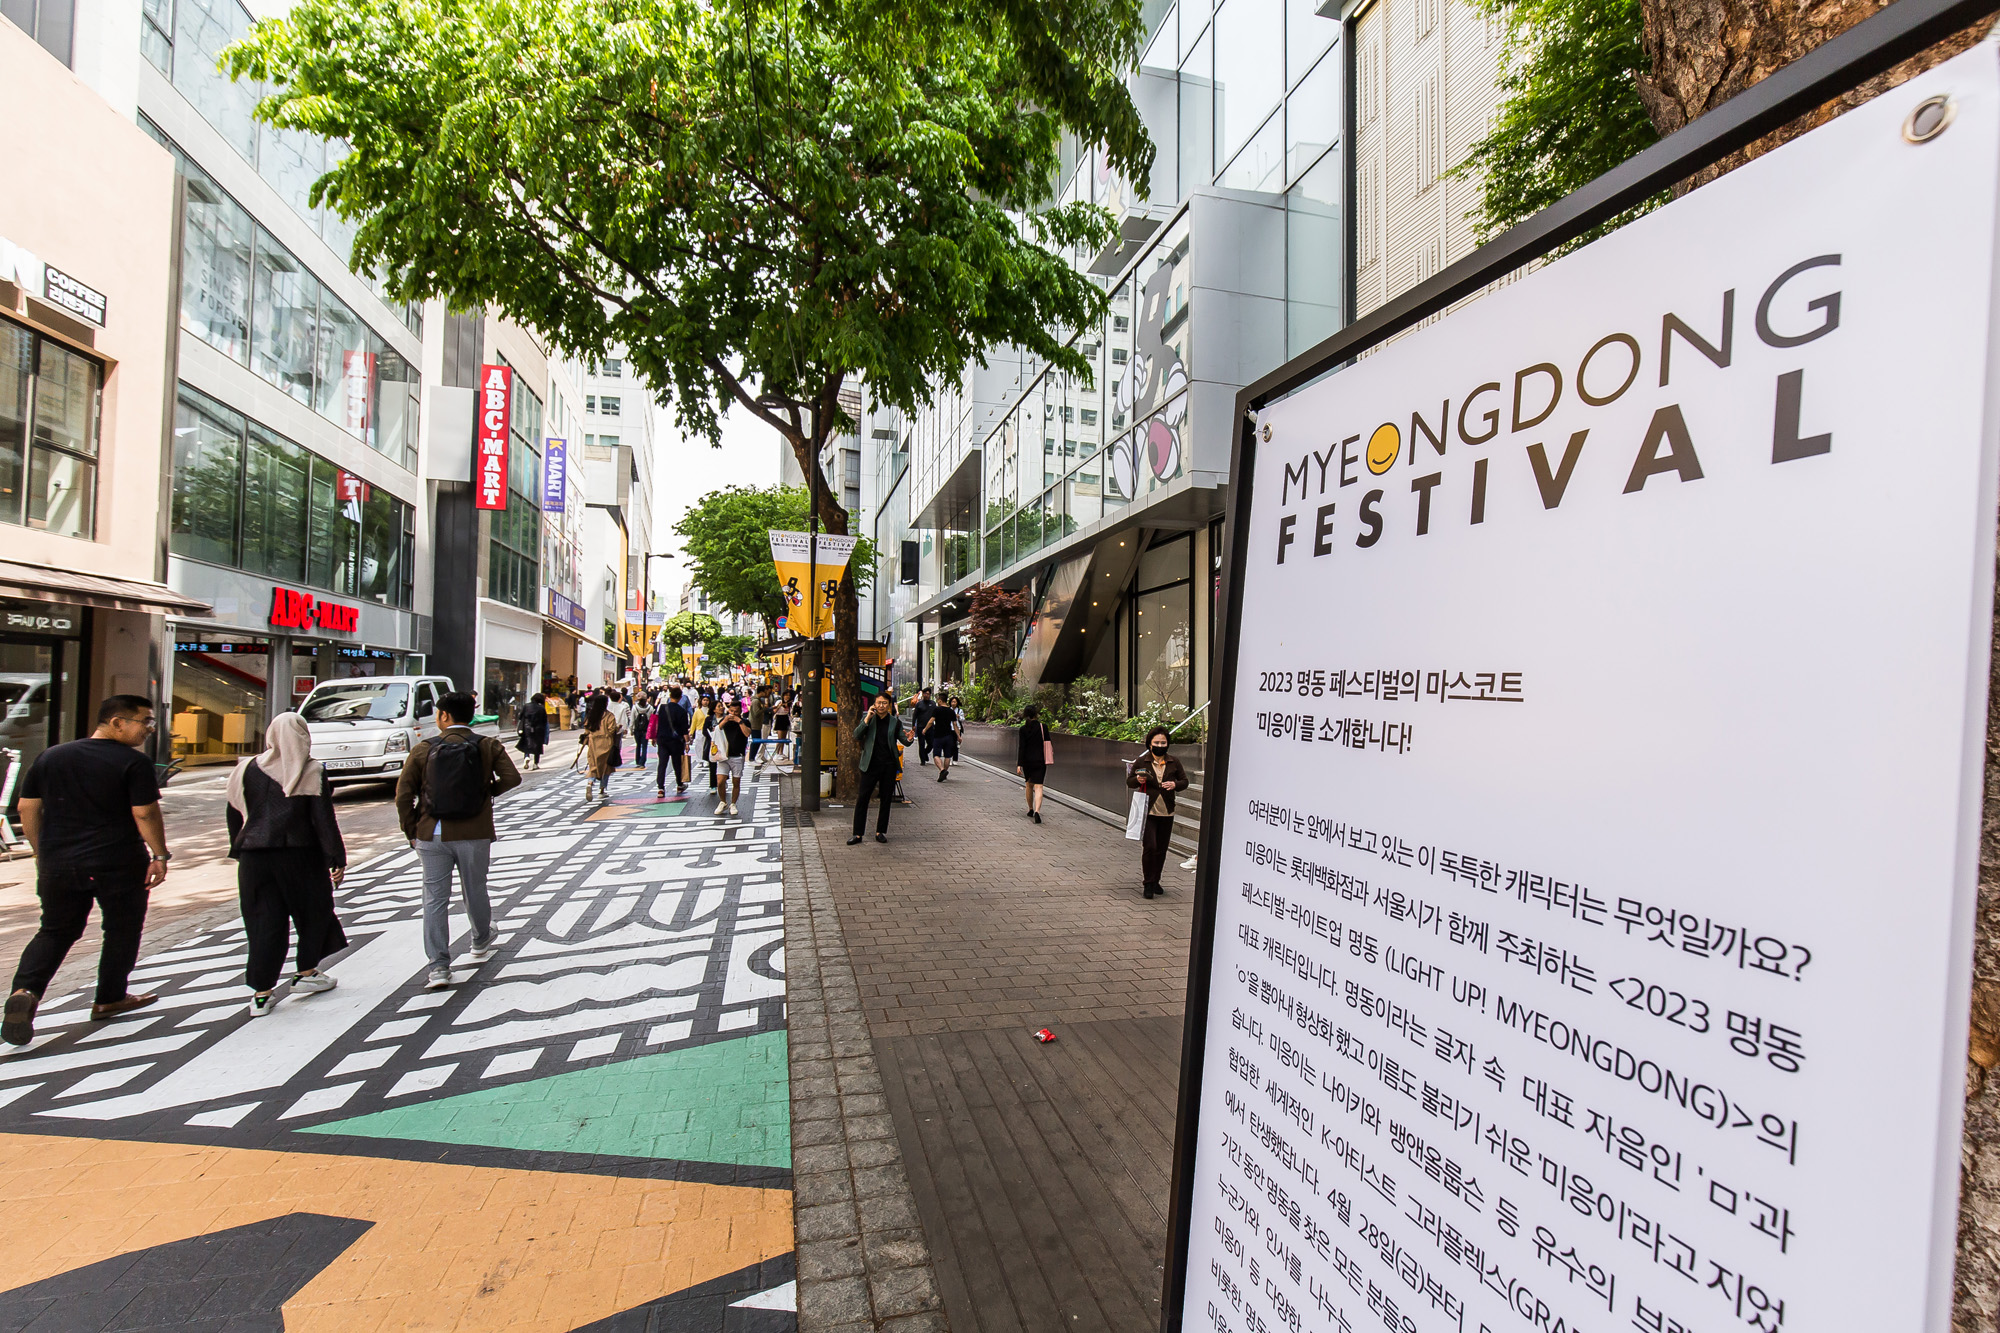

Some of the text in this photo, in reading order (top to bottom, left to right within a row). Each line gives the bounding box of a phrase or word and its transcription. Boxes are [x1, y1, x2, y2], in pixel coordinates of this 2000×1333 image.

[46, 267, 106, 310] COFFEE
[1276, 368, 1833, 566] FESTIVAL
[1282, 253, 1842, 507] MYEONGDONG
[547, 440, 563, 500] K-MART
[771, 537, 809, 545] FESTIVAL
[818, 540, 855, 548] FESTIVAL
[1256, 711, 1413, 754] '미응이'를 소개합니다!
[1259, 669, 1524, 703] 2023 명동 페스티벌의 마스코트
[1245, 840, 1806, 1073] 미응이는 롯데백화점과 서울시가 함께 주최하는 <2023 명동
[1248, 799, 1812, 982] 여러분이 눈 앞에서 보고 있는 이 독특한 캐릭터는 무엇일까요?
[1238, 923, 1260, 951] 대표
[1262, 935, 1339, 997] 캐릭터입니다.
[1344, 979, 1428, 1048] 명동이라는
[1433, 1026, 1476, 1075] 글자
[1482, 1055, 1506, 1092] 속
[1523, 1075, 1575, 1129] 대표
[1584, 1107, 1682, 1192] 자음인
[1242, 881, 1797, 1166] 페스티벌-라이트업 명동 (LIGHT UP! MYEONGDONG)>의
[1221, 1131, 1243, 1167] 기간
[1243, 1152, 1266, 1192] 동안
[1266, 1175, 1301, 1232] 명동을
[1303, 1215, 1331, 1262] 찾은
[1332, 1246, 1363, 1296] 모든
[1225, 1089, 1464, 1333] 에서 탄생했답니다. 4월 28일(금)부터
[1228, 1046, 1580, 1333] 협업한 세계적인 K-아티스트 그라플렉스(GRA
[1231, 1006, 1264, 1046] 습니다.
[1269, 1033, 1317, 1087] 미응이는
[1322, 1071, 1381, 1136] 나이키와
[1389, 1118, 1485, 1214] 뱅앤올룹슨
[1496, 1196, 1520, 1238] 등
[1531, 1225, 1615, 1313] 유수의
[1260, 978, 1294, 1021] 뽑아내
[1295, 1000, 1334, 1047] 형상화
[1336, 1026, 1365, 1066] 했고
[1368, 1049, 1418, 1101] 이름도
[1421, 1080, 1480, 1145] 불리기
[1484, 1122, 1532, 1177] 쉬운
[1538, 1152, 1699, 1284] '미응이'라고
[1210, 1258, 1242, 1313] 비롯한
[1214, 1216, 1302, 1333] 미응이 등 다양한
[1217, 1173, 1260, 1236] 누군가와
[1266, 1227, 1302, 1286] 인사를
